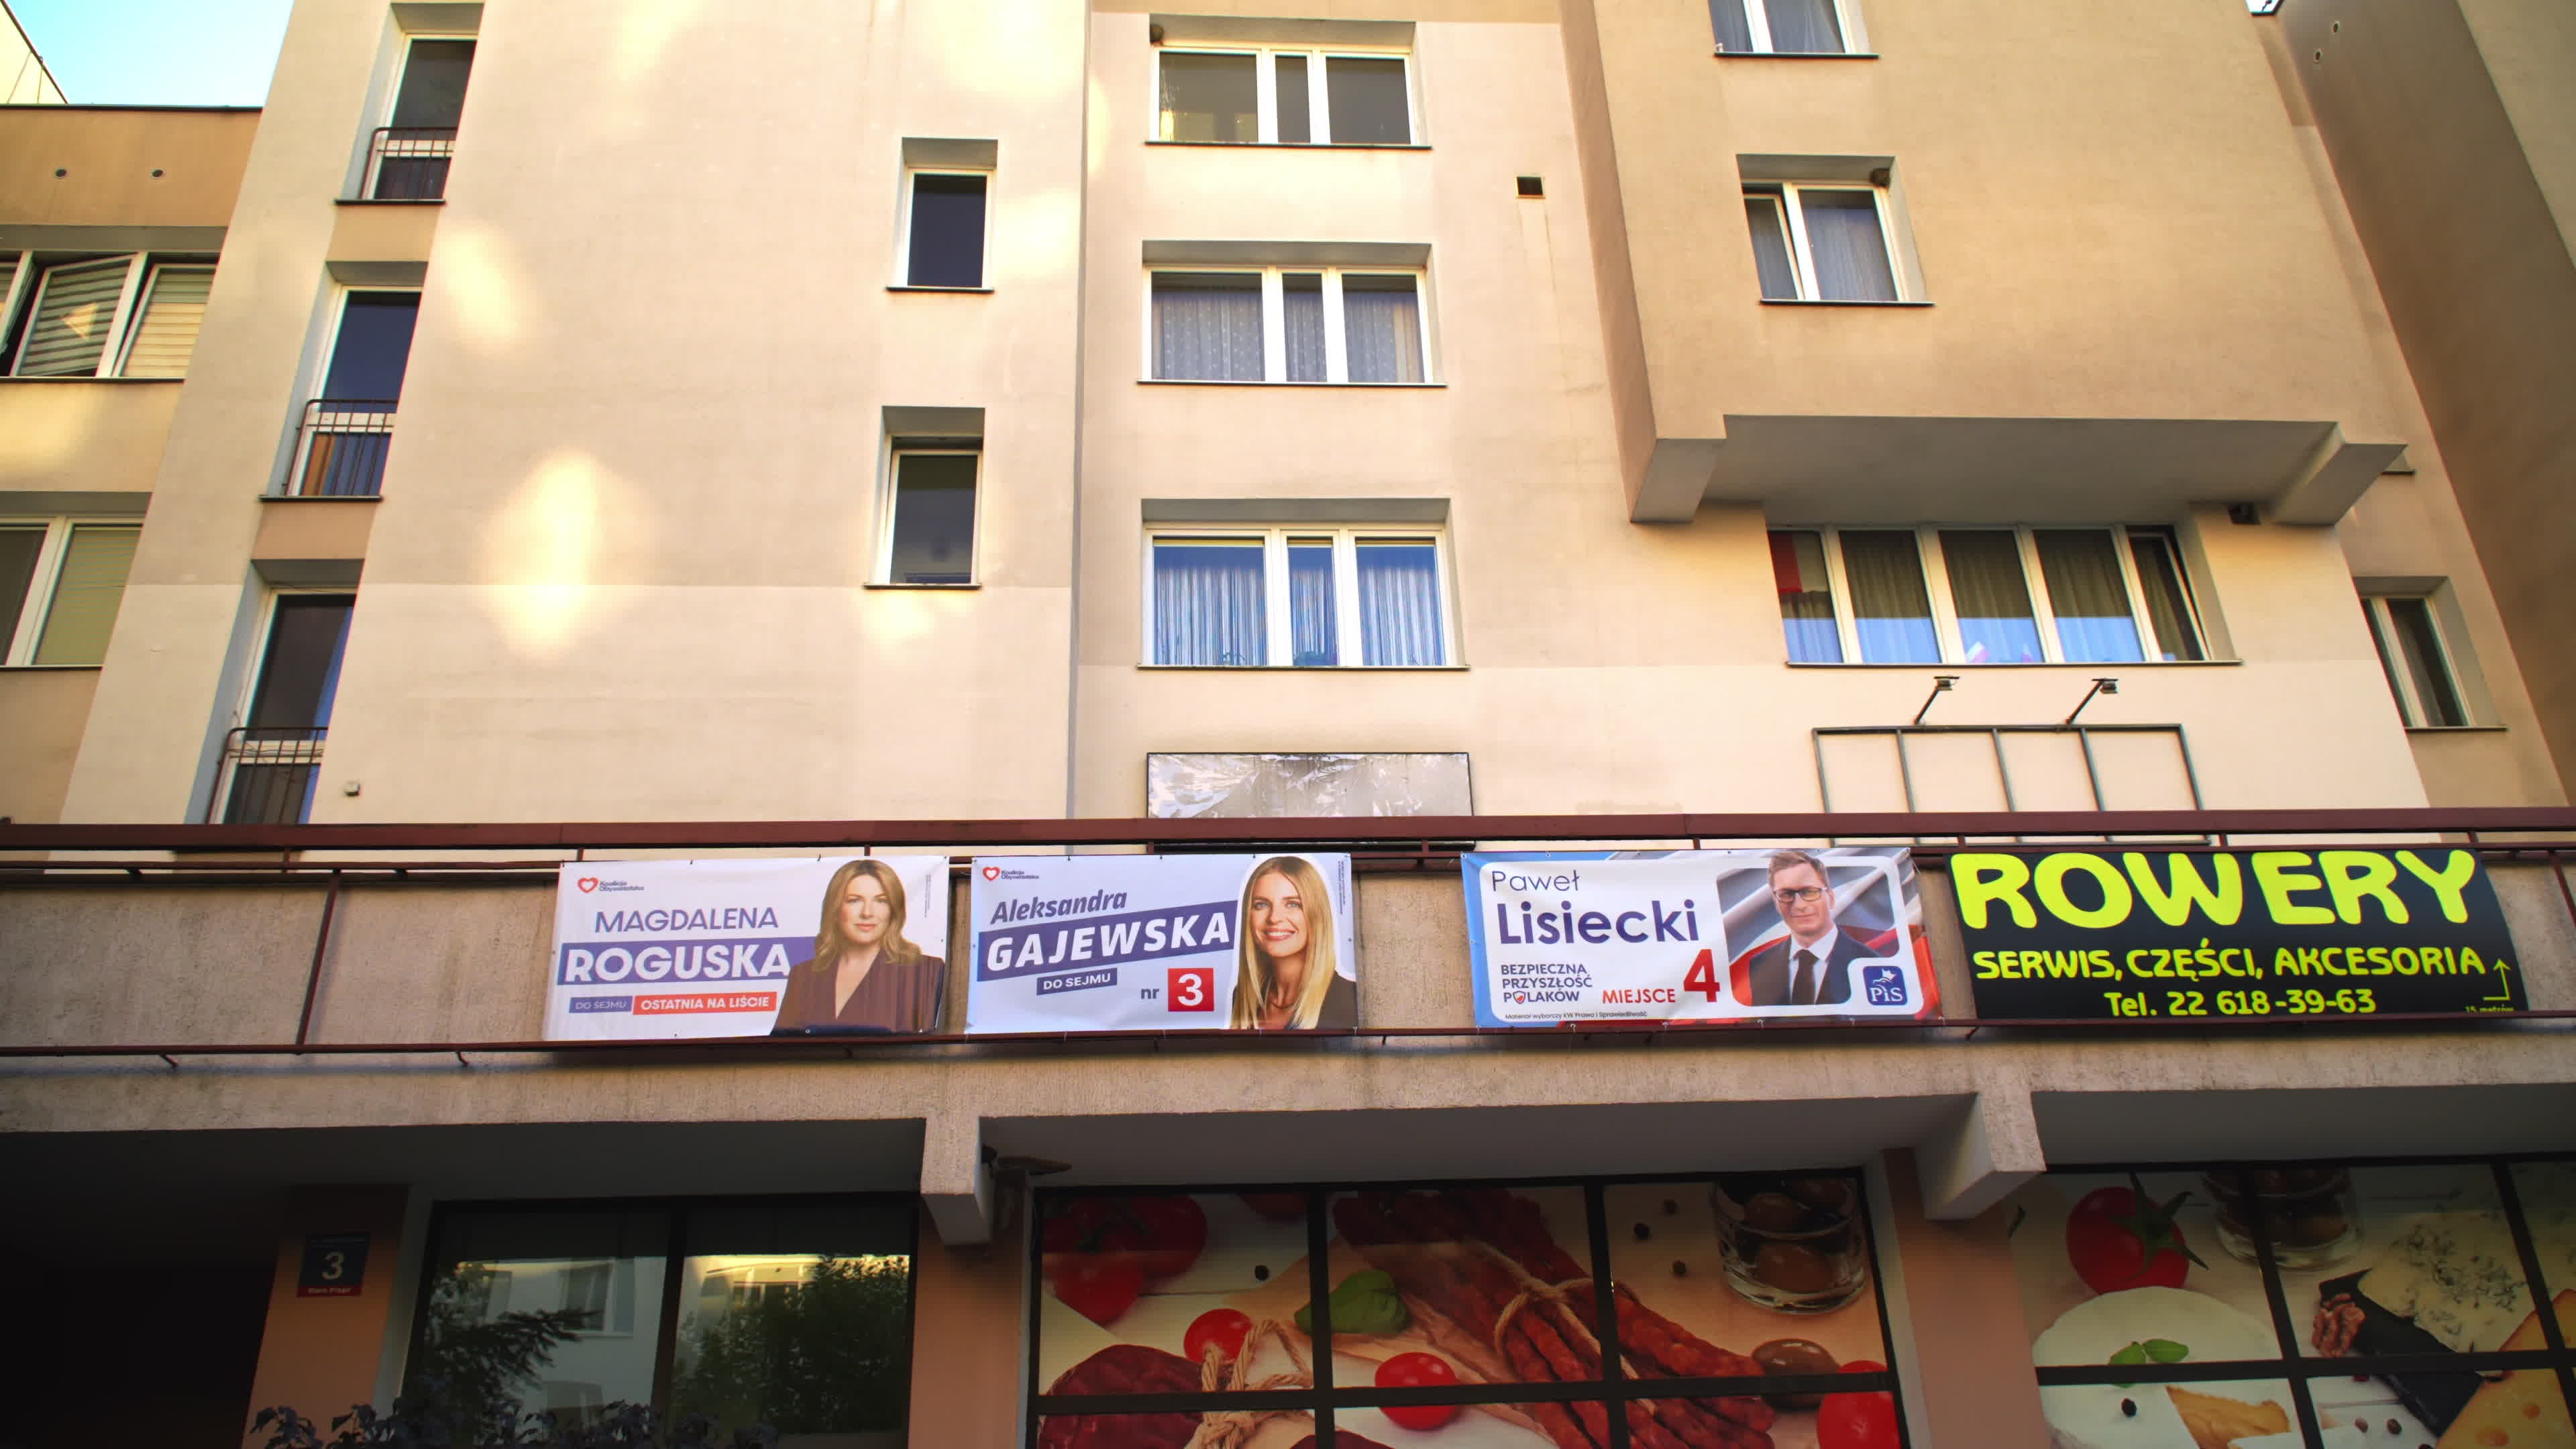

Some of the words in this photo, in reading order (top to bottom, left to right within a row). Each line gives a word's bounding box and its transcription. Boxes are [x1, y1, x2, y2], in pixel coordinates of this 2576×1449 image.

[1492, 870, 1580, 892] Paweł
[1950, 850, 2476, 928] ROWERY
[595, 907, 778, 932] MAGDALENA
[990, 890, 1127, 924] Aleksandra
[1497, 899, 1699, 945] Lisiecki
[987, 912, 1230, 971] GAJEWSKA
[565, 944, 791, 981] ROGUSKA
[1501, 964, 1587, 975] BEZPIECZNA
[1973, 950, 2123, 981] SERWIS,
[2127, 938, 2263, 981] CZĘŚCI,
[2274, 947, 2485, 975] AKCESORIA
[1043, 980, 1063, 990] DO
[1066, 973, 1111, 987] SEJMU
[1140, 986, 1159, 1000] nr
[1177, 973, 1203, 1006] 3
[1503, 974, 1593, 989] PRZYSZŁOŚĆ
[1602, 989, 1676, 1004] MIEJSCE
[1683, 949, 1721, 1002] 4
[594, 1000, 627, 1010] SEJMU
[641, 998, 704, 1010] OSTATNIA
[707, 998, 726, 1008] NA
[729, 995, 770, 1008] LIŚCIE
[1870, 986, 1903, 1002] PiS
[2104, 992, 2157, 1016] Tel.
[2167, 991, 2207, 1015] 22
[322, 1252, 344, 1280] 3
